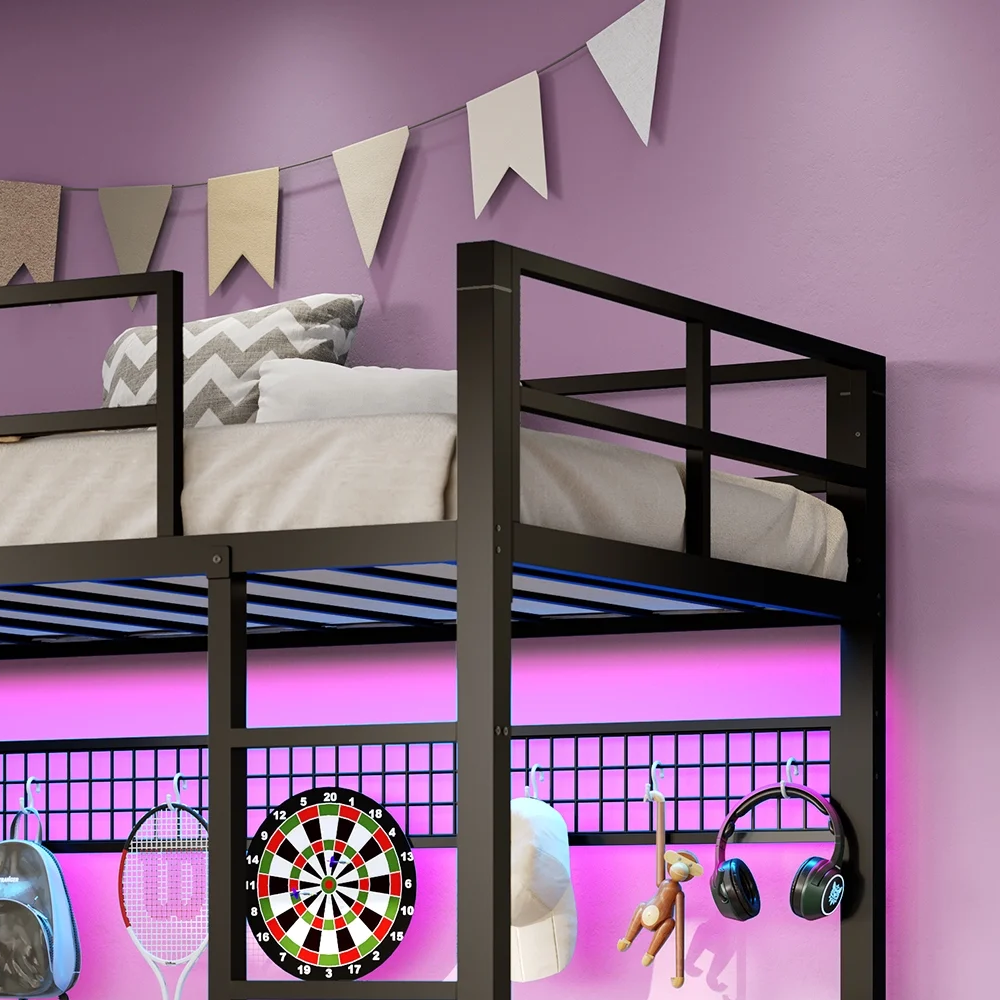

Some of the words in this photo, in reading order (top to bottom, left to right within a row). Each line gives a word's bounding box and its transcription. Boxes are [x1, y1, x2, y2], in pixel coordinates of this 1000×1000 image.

[300, 797, 308, 806] 5
[323, 792, 338, 802] 20
[348, 797, 355, 806] 1
[273, 810, 287, 820] 12
[369, 809, 383, 819] 18
[260, 831, 268, 841] 9
[388, 828, 396, 837] 4
[246, 854, 259, 865] 14
[400, 852, 414, 861] 13
[245, 880, 256, 891] 11
[404, 879, 412, 889] 6
[250, 907, 258, 916] 8
[400, 906, 415, 916] 10
[256, 932, 270, 942] 16
[389, 932, 404, 941] 15
[279, 952, 287, 962] 7
[372, 951, 380, 961] 2
[297, 965, 311, 975] 19
[325, 968, 333, 978] 3
[347, 965, 362, 975] 17
